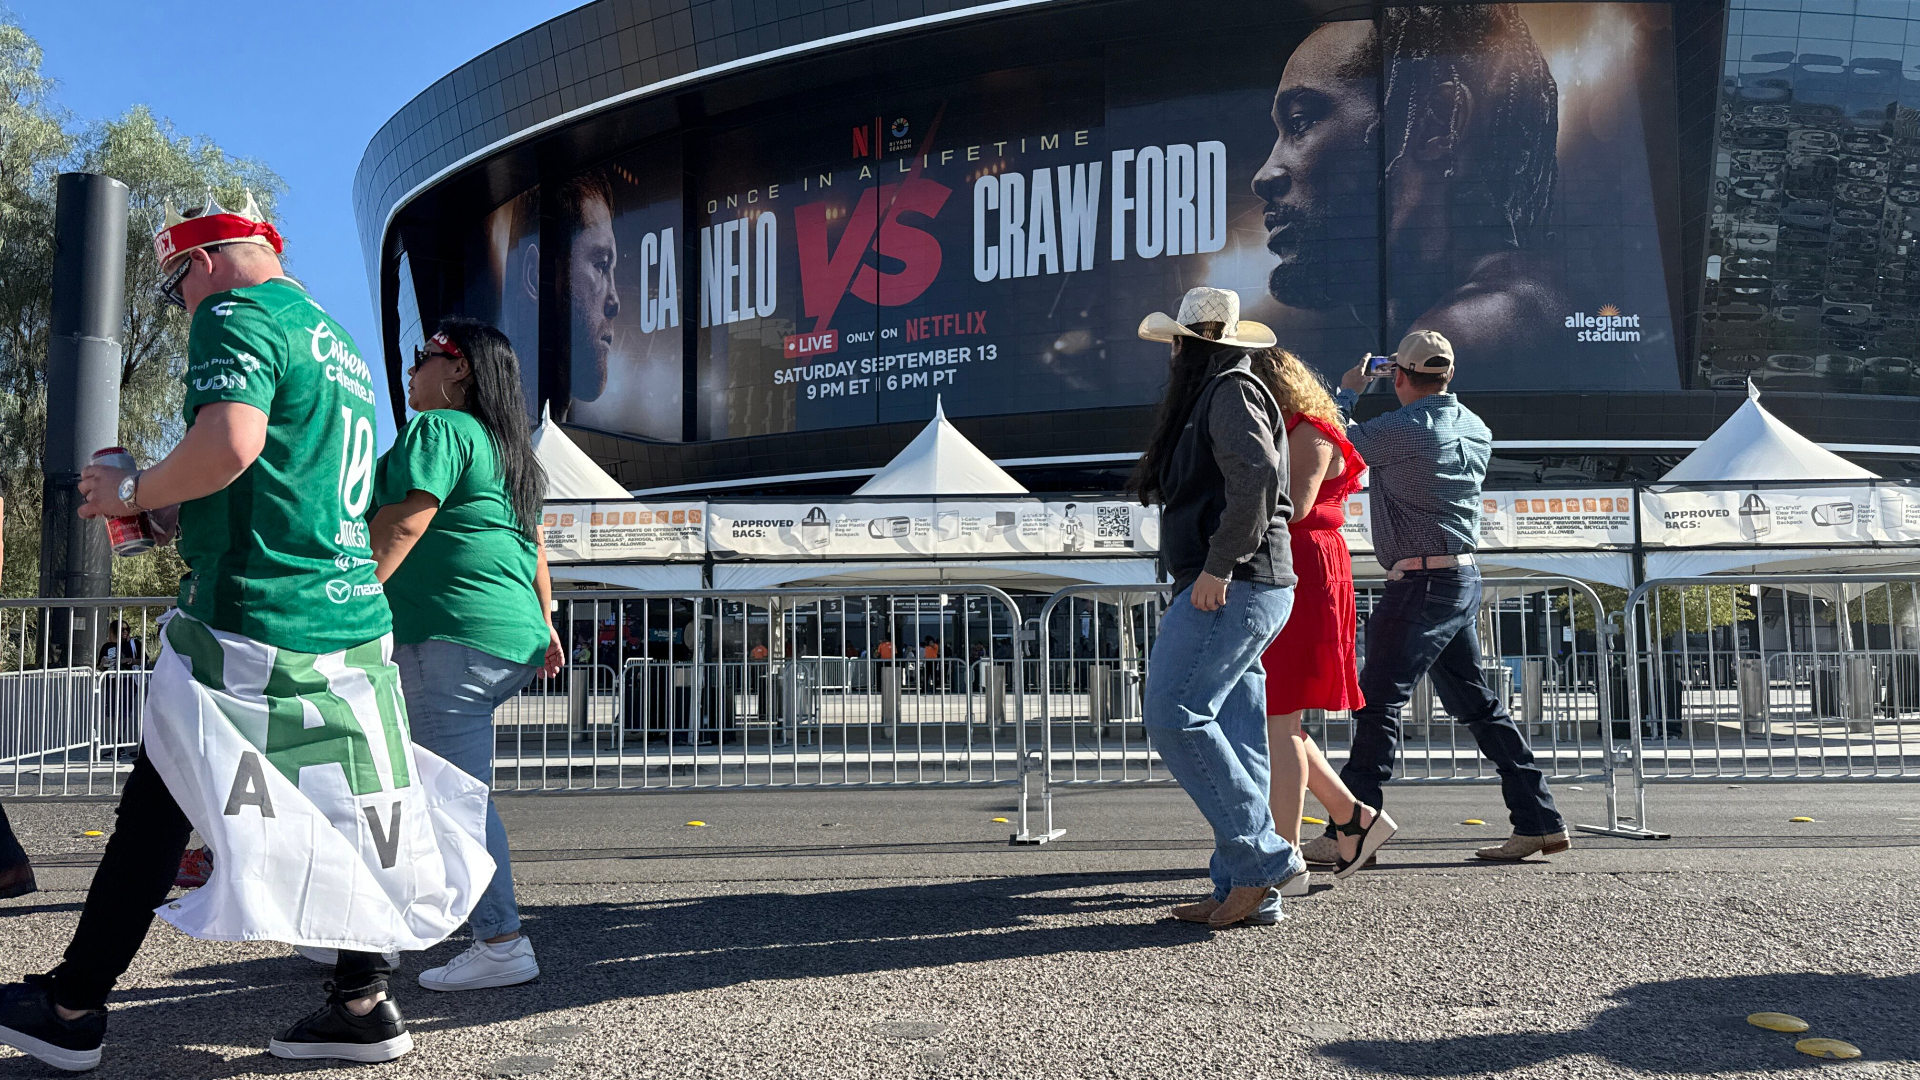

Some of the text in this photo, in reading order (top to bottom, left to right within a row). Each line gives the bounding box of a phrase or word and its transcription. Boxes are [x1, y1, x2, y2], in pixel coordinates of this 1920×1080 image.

[889, 139, 912, 147] RIYADH
[889, 144, 912, 152] SEASON
[707, 130, 1090, 214] ONCE IN A LIFETIME
[794, 178, 953, 322] VS
[1564, 312, 1640, 331] allegiant
[799, 310, 987, 353] LIVE ONLY ON NETFLIX
[1577, 328, 1640, 342] stadium
[773, 344, 998, 385] SATURDAY SEPTEMBER 13
[849, 379, 871, 395] ET
[933, 369, 957, 386] PT
[338, 404, 374, 518] 10
[1664, 509, 1730, 519] APPROVED
[732, 519, 794, 528] APPROVED
[1665, 520, 1701, 529] BAGS:
[732, 529, 766, 538] BAGS:
[732, 604, 738, 612] 5
[830, 602, 837, 610] 5
[969, 601, 976, 609] 4
[223, 750, 276, 819] A
[362, 800, 402, 870] V
